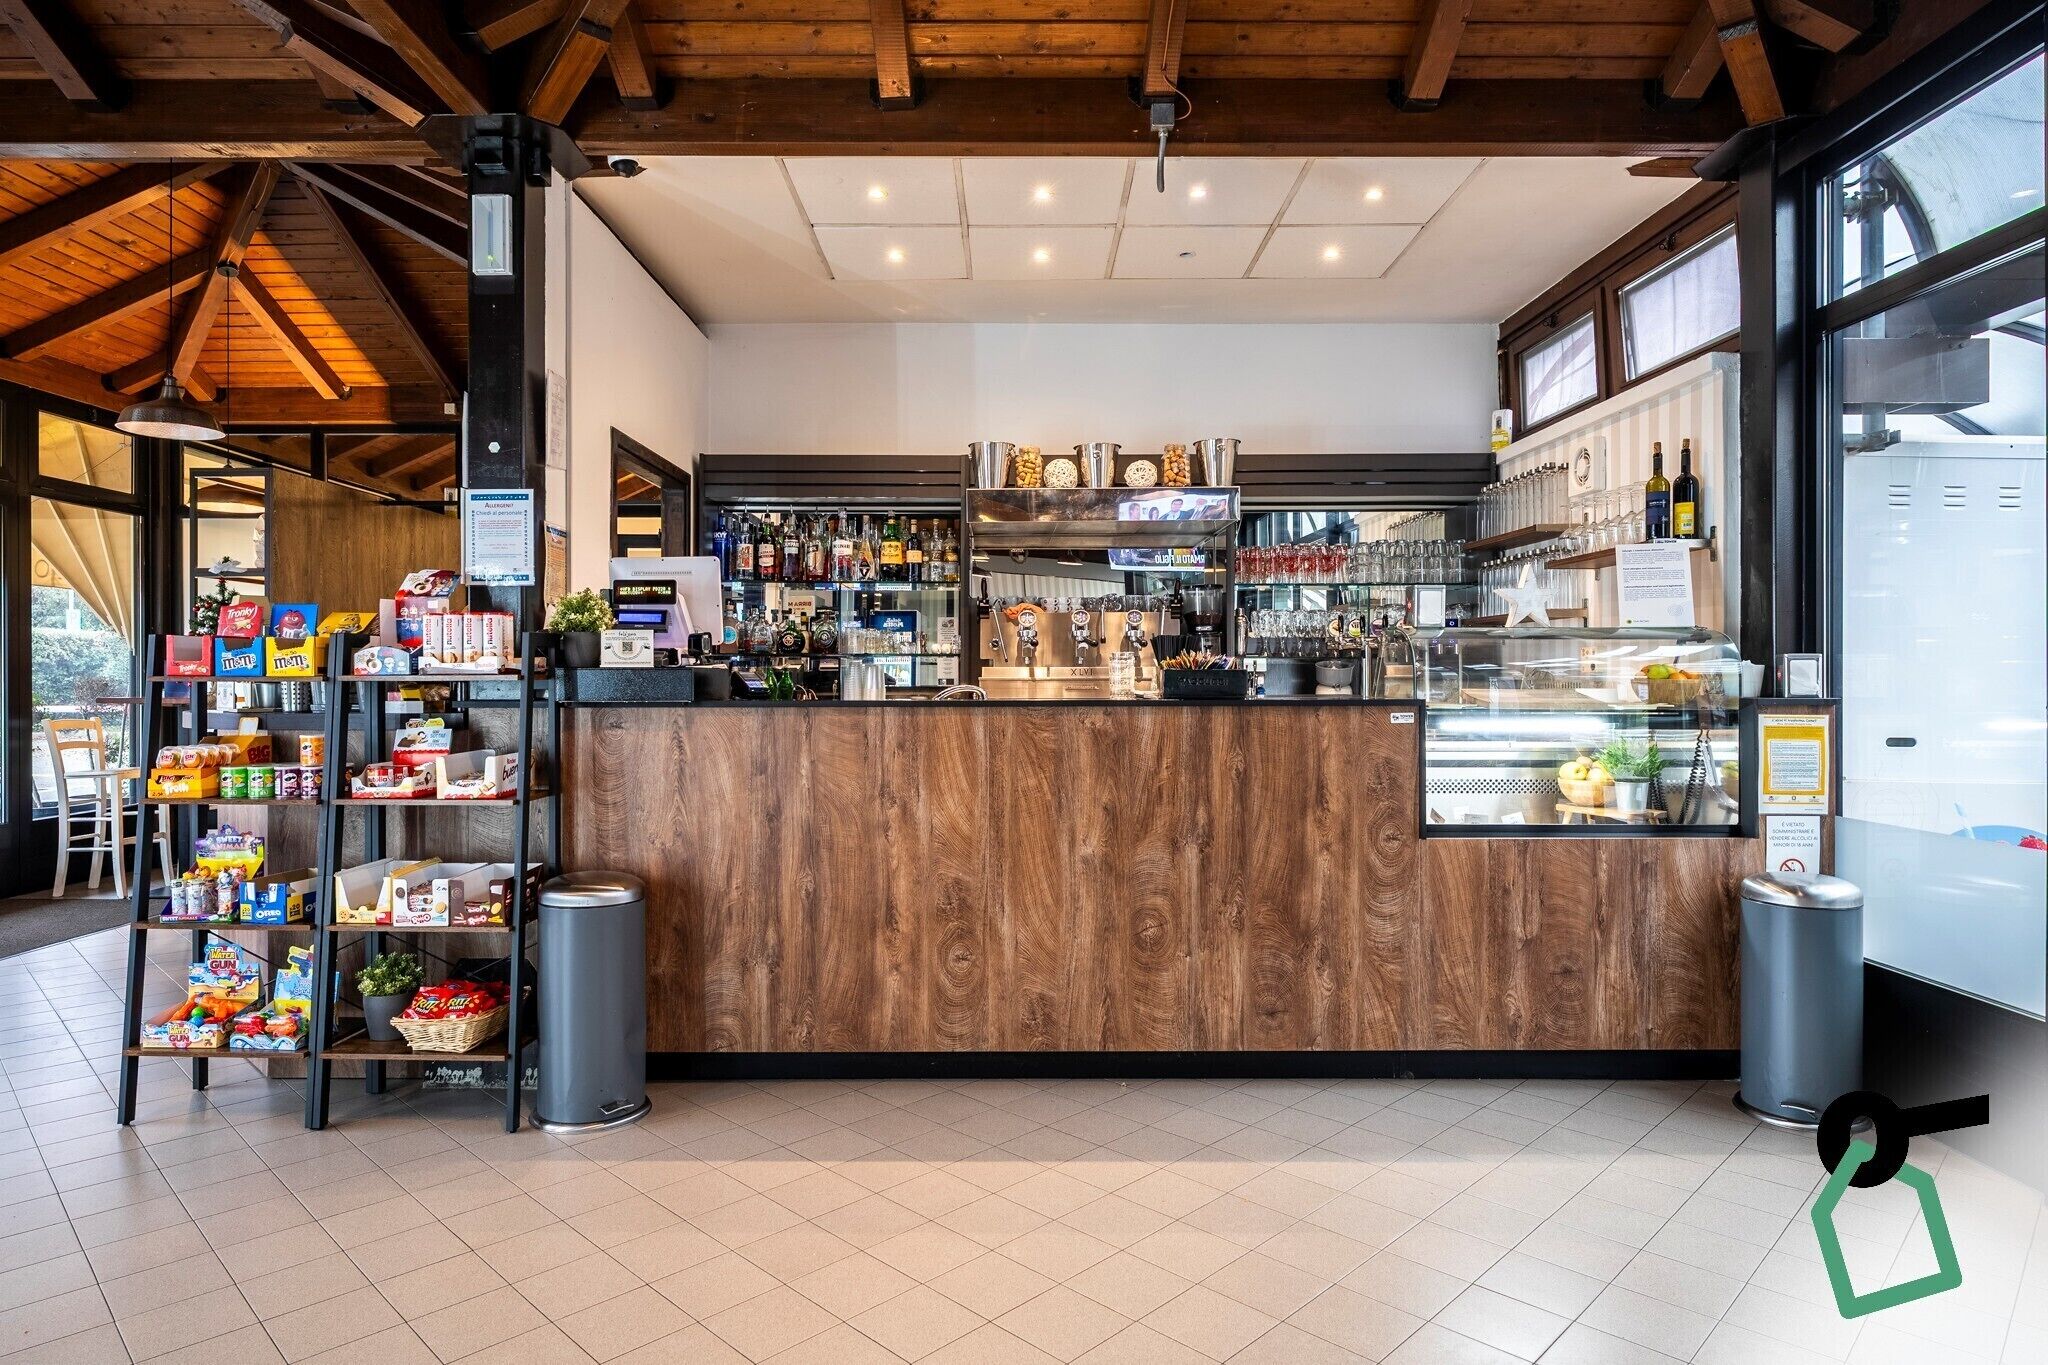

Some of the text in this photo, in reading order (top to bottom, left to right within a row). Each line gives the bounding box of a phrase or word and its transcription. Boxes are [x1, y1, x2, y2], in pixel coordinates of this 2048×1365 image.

[228, 607, 254, 620] Tronky
[179, 663, 198, 673] Tronky
[246, 744, 271, 764] BIG
[502, 764, 519, 781] buen
[215, 835, 242, 843] SWEET
[255, 909, 282, 920] OREO
[209, 948, 235, 960] WATER
[209, 960, 236, 970] GUN
[415, 998, 440, 1010] RITZ
[447, 997, 471, 1007] RITZ
[415, 1006, 430, 1014] mini
[168, 1024, 189, 1035] WATER
[168, 1034, 190, 1042] GUN
